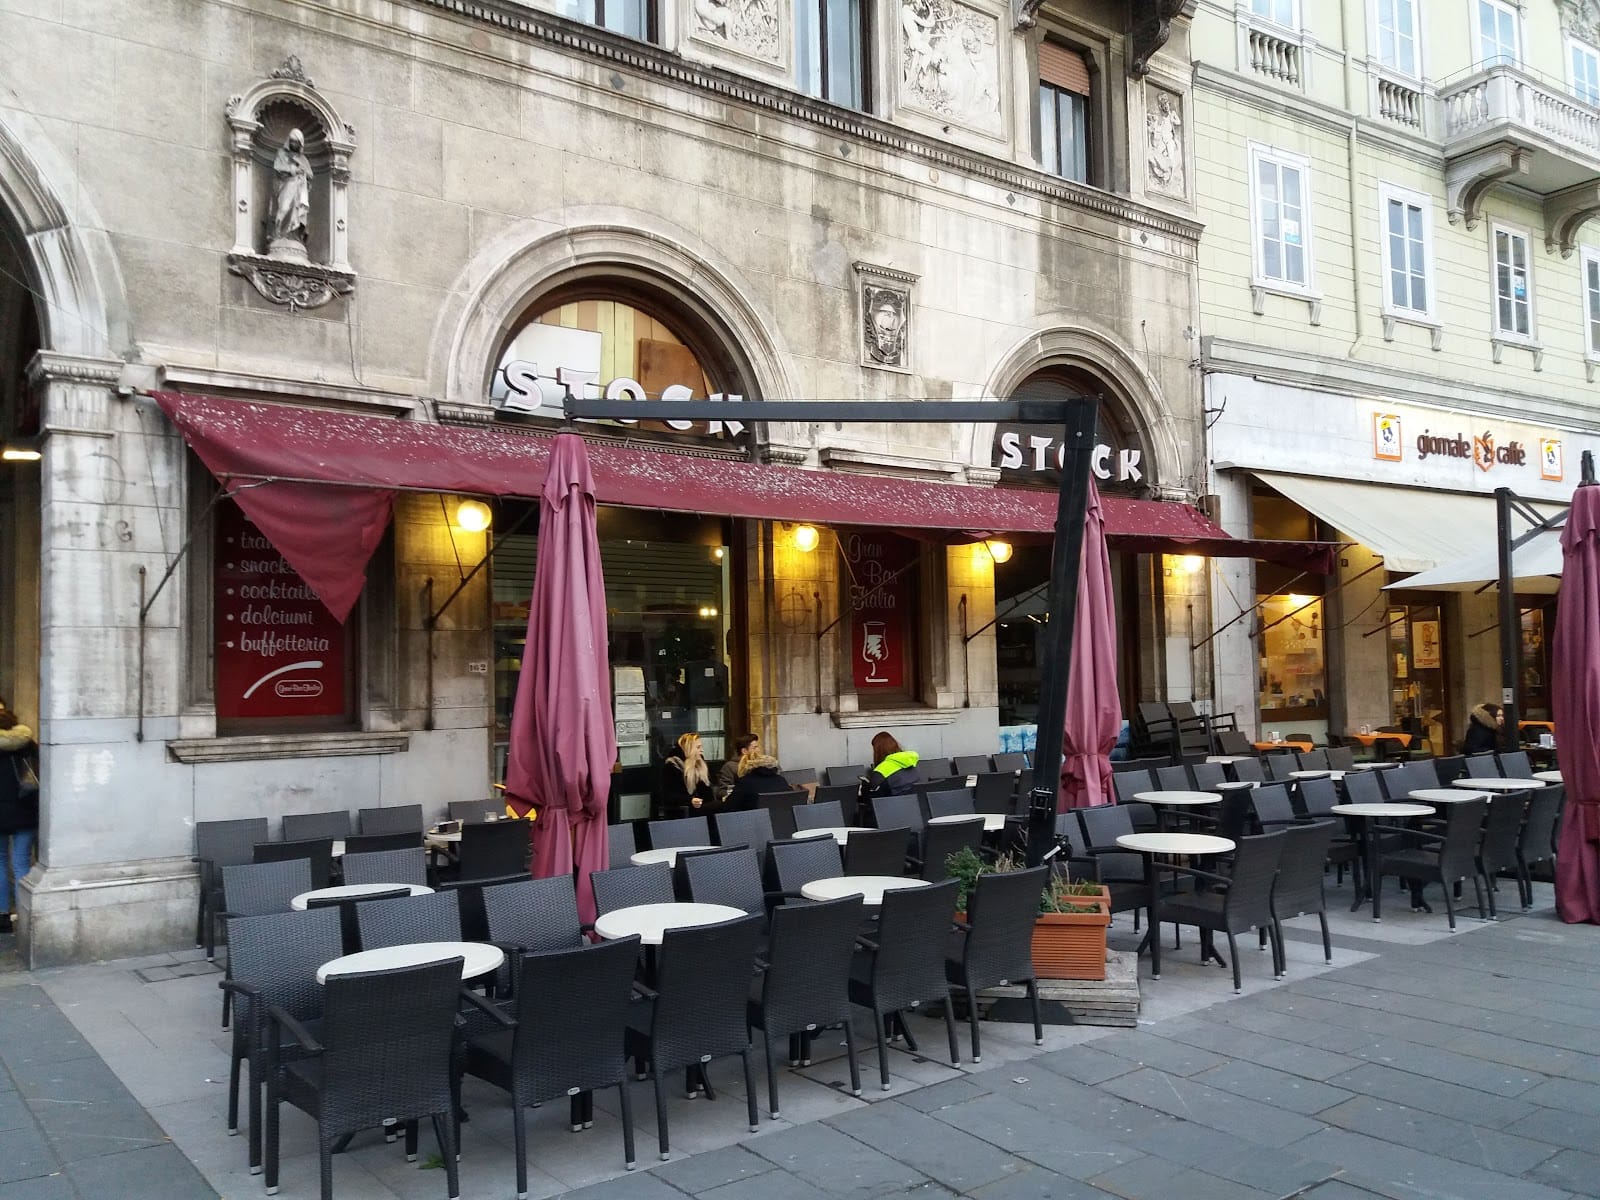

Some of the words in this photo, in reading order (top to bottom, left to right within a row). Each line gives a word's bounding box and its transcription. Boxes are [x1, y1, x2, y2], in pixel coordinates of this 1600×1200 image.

[1000, 432, 1143, 483] STCK
[1417, 429, 1472, 460] giornale
[240, 603, 314, 625] dolciumi
[240, 631, 329, 657] buffetteria
